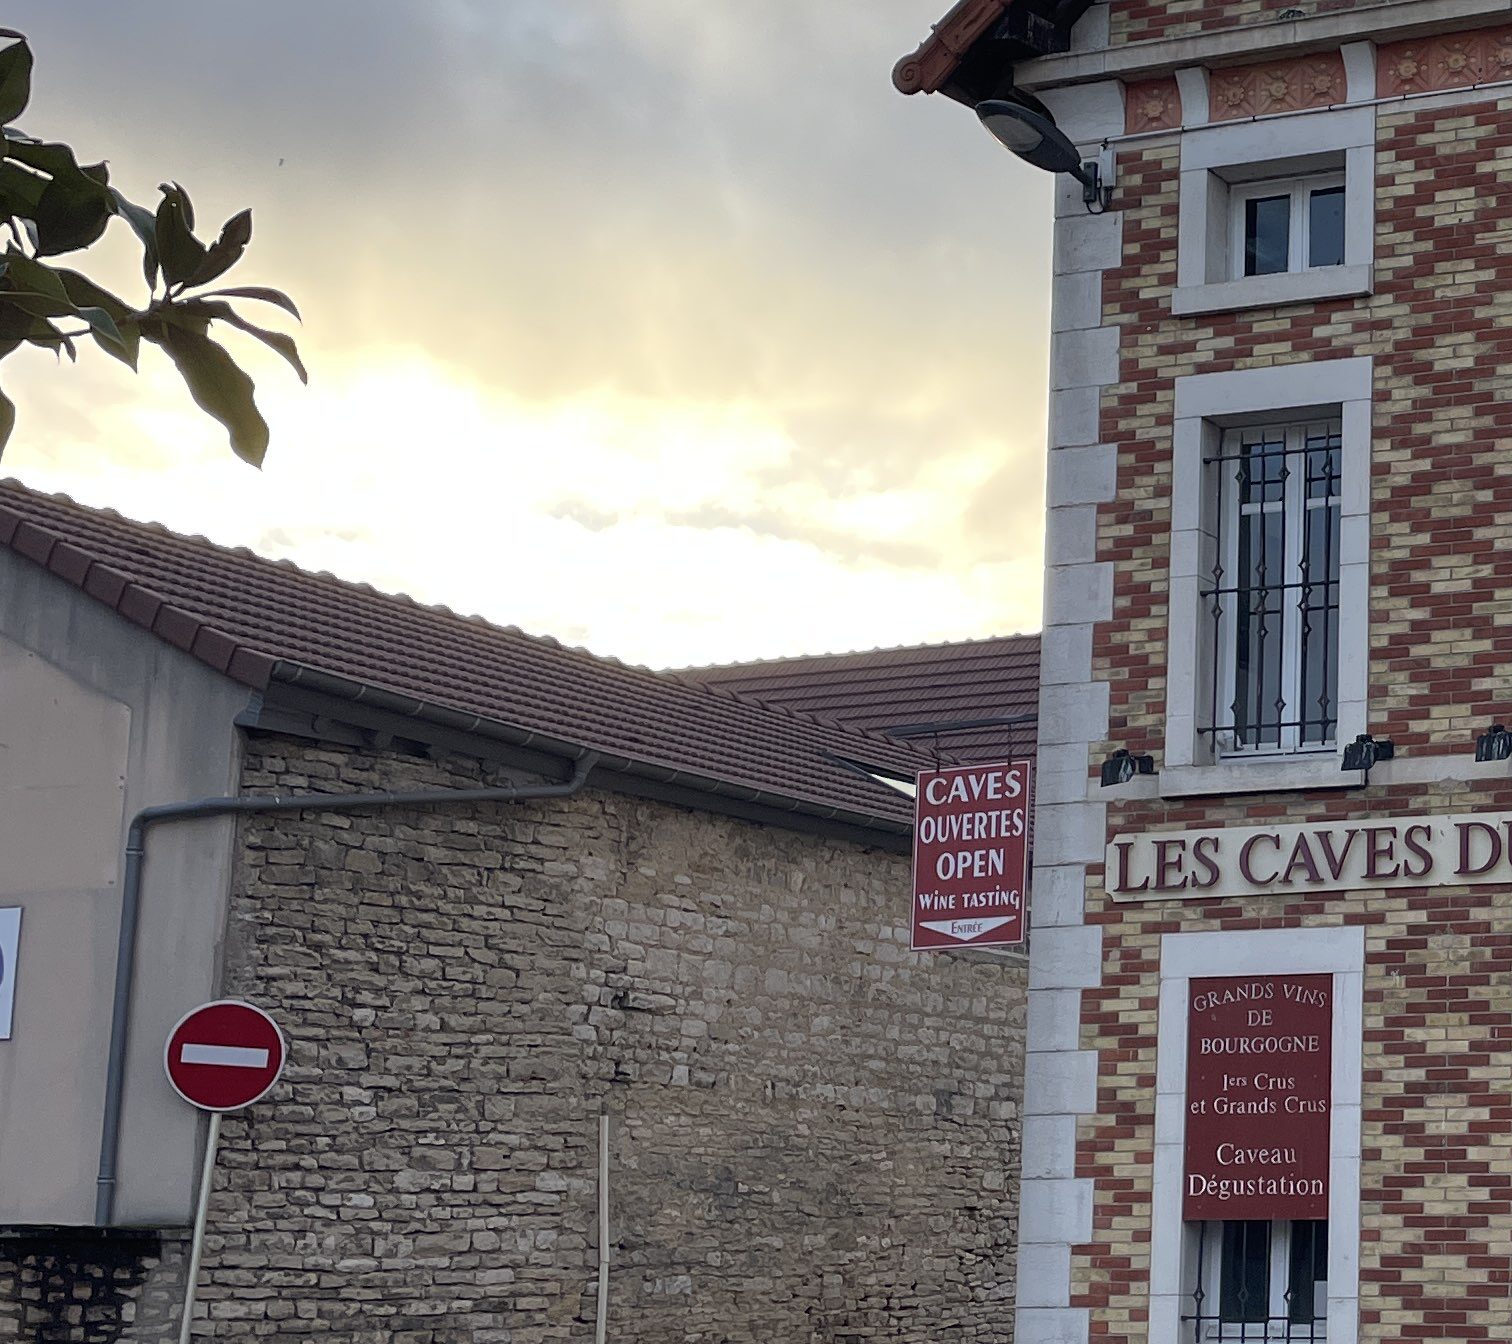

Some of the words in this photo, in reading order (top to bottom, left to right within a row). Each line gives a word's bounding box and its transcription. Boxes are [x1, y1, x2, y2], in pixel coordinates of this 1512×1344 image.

[926, 770, 1022, 805] CAVES
[920, 808, 1024, 844] OUVERTES
[936, 848, 1005, 881] OPEN
[1113, 836, 1220, 893] LES
[1240, 824, 1432, 886] CAVES
[1193, 982, 1275, 1012] GRANDS
[1283, 983, 1327, 1008] VINS
[1247, 1009, 1273, 1026] DE
[1200, 1036, 1320, 1055] BOURGOGNE
[1254, 1073, 1295, 1090] Crus
[1190, 1100, 1206, 1114] et
[1214, 1097, 1277, 1115] Grands
[1285, 1096, 1327, 1113] Crus
[1216, 1143, 1297, 1166] Caveau
[1188, 1173, 1324, 1200] Dégustation
